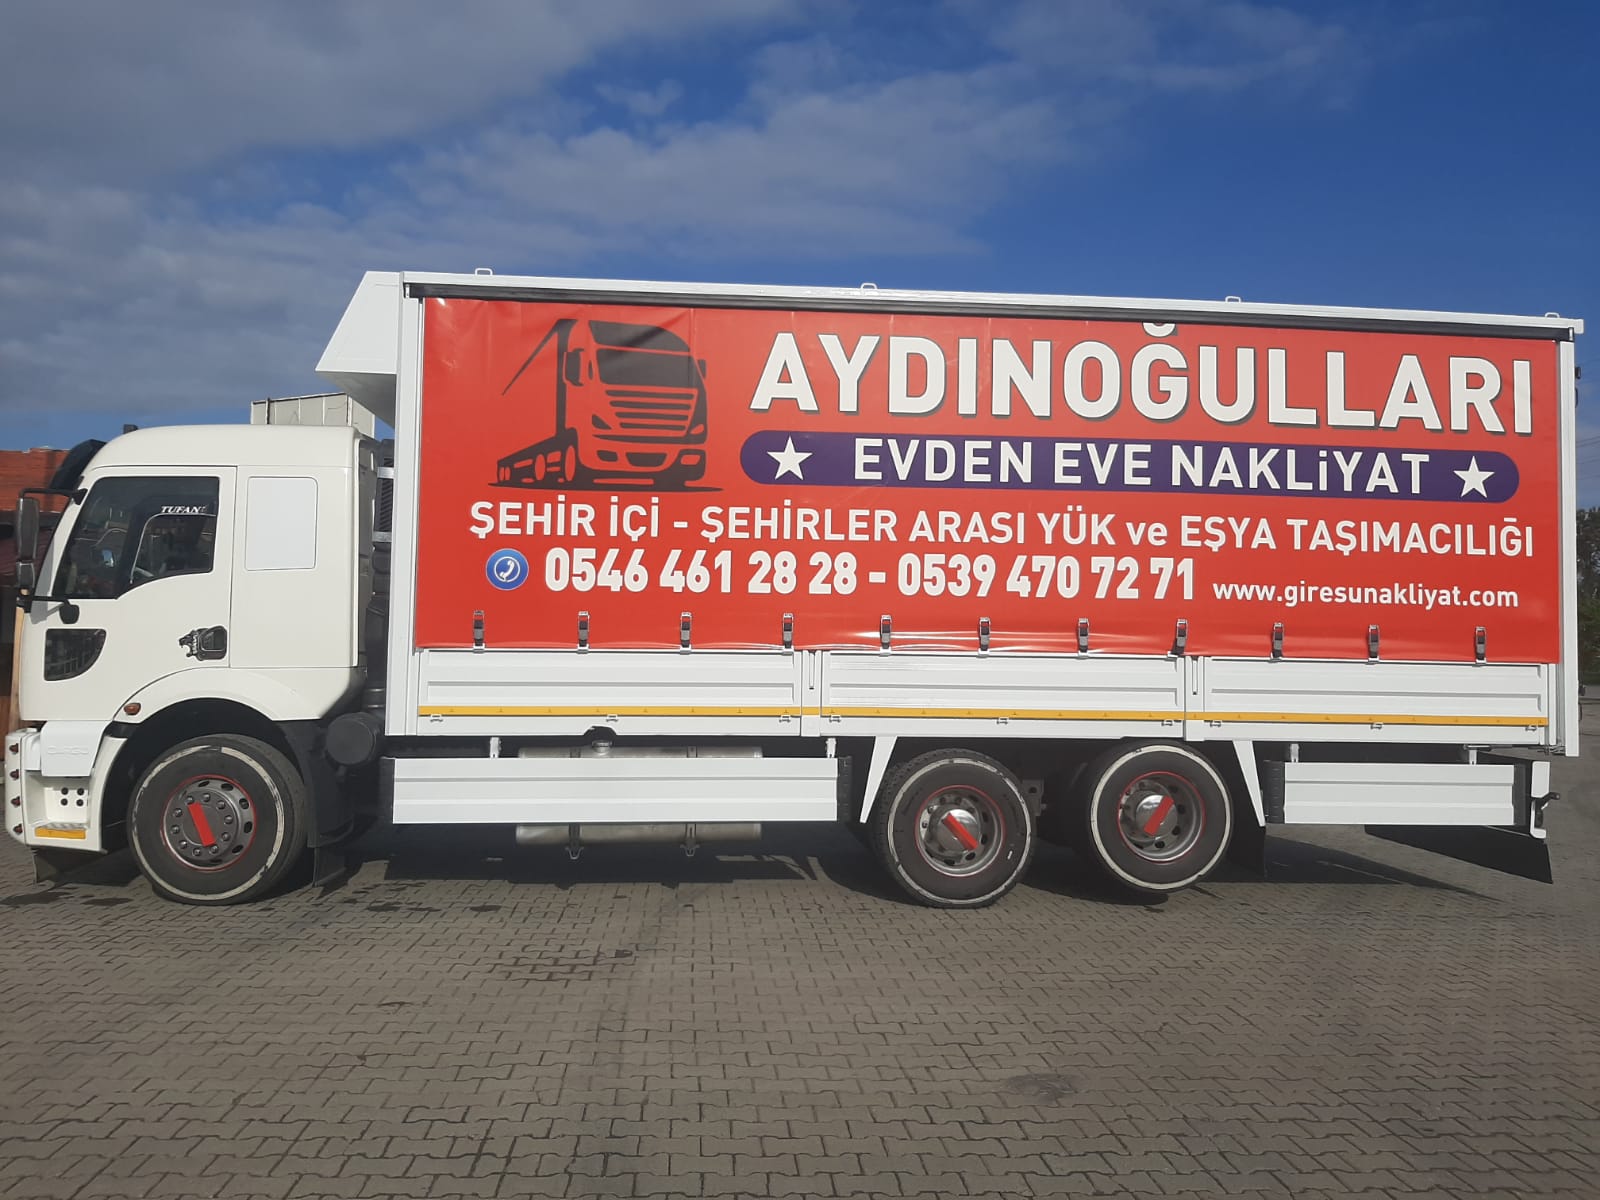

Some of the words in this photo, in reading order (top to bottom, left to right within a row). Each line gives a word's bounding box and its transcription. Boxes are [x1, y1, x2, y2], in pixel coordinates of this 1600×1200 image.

[749, 322, 1534, 436] AYDINOĞULLARI
[854, 437, 1032, 484] EVDEN
[1054, 442, 1152, 486] EVE
[161, 505, 202, 514] TUFAN
[469, 494, 596, 540] ŞEHİR
[609, 495, 660, 542] İÇİ
[673, 521, 689, 529] -
[700, 498, 898, 544] ŞEHİRLER
[908, 510, 1025, 545] ARASI
[1037, 504, 1116, 546] YÜK
[1125, 522, 1168, 546] ve
[1180, 515, 1277, 553] EŞYA
[544, 547, 649, 592] 0546
[659, 549, 732, 593] 461
[747, 550, 797, 594] 28
[808, 551, 858, 595] 28
[868, 571, 887, 584] -
[897, 552, 996, 598] 0539
[1006, 554, 1081, 599] 470
[1090, 556, 1140, 600] 72
[1149, 556, 1194, 600] 71
[1212, 580, 1519, 611] www.giresunakliyat.com
